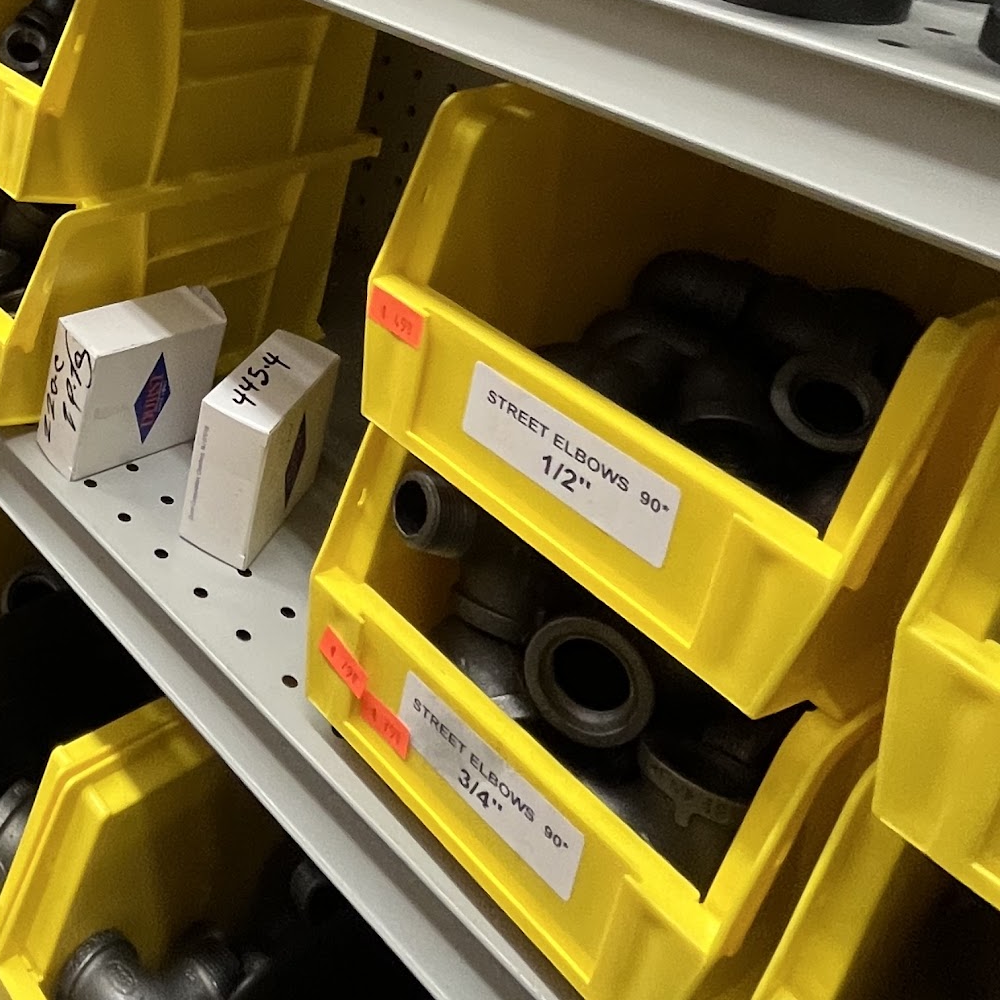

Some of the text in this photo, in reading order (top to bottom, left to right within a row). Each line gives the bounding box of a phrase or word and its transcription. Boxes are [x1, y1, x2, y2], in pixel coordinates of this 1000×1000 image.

[486, 389, 550, 438] STREET
[552, 433, 630, 492] ELBOWS
[541, 454, 592, 494] 1/2"
[412, 698, 467, 754] STREET
[469, 752, 535, 823] ELBOWS
[456, 768, 504, 812] 3/4"
